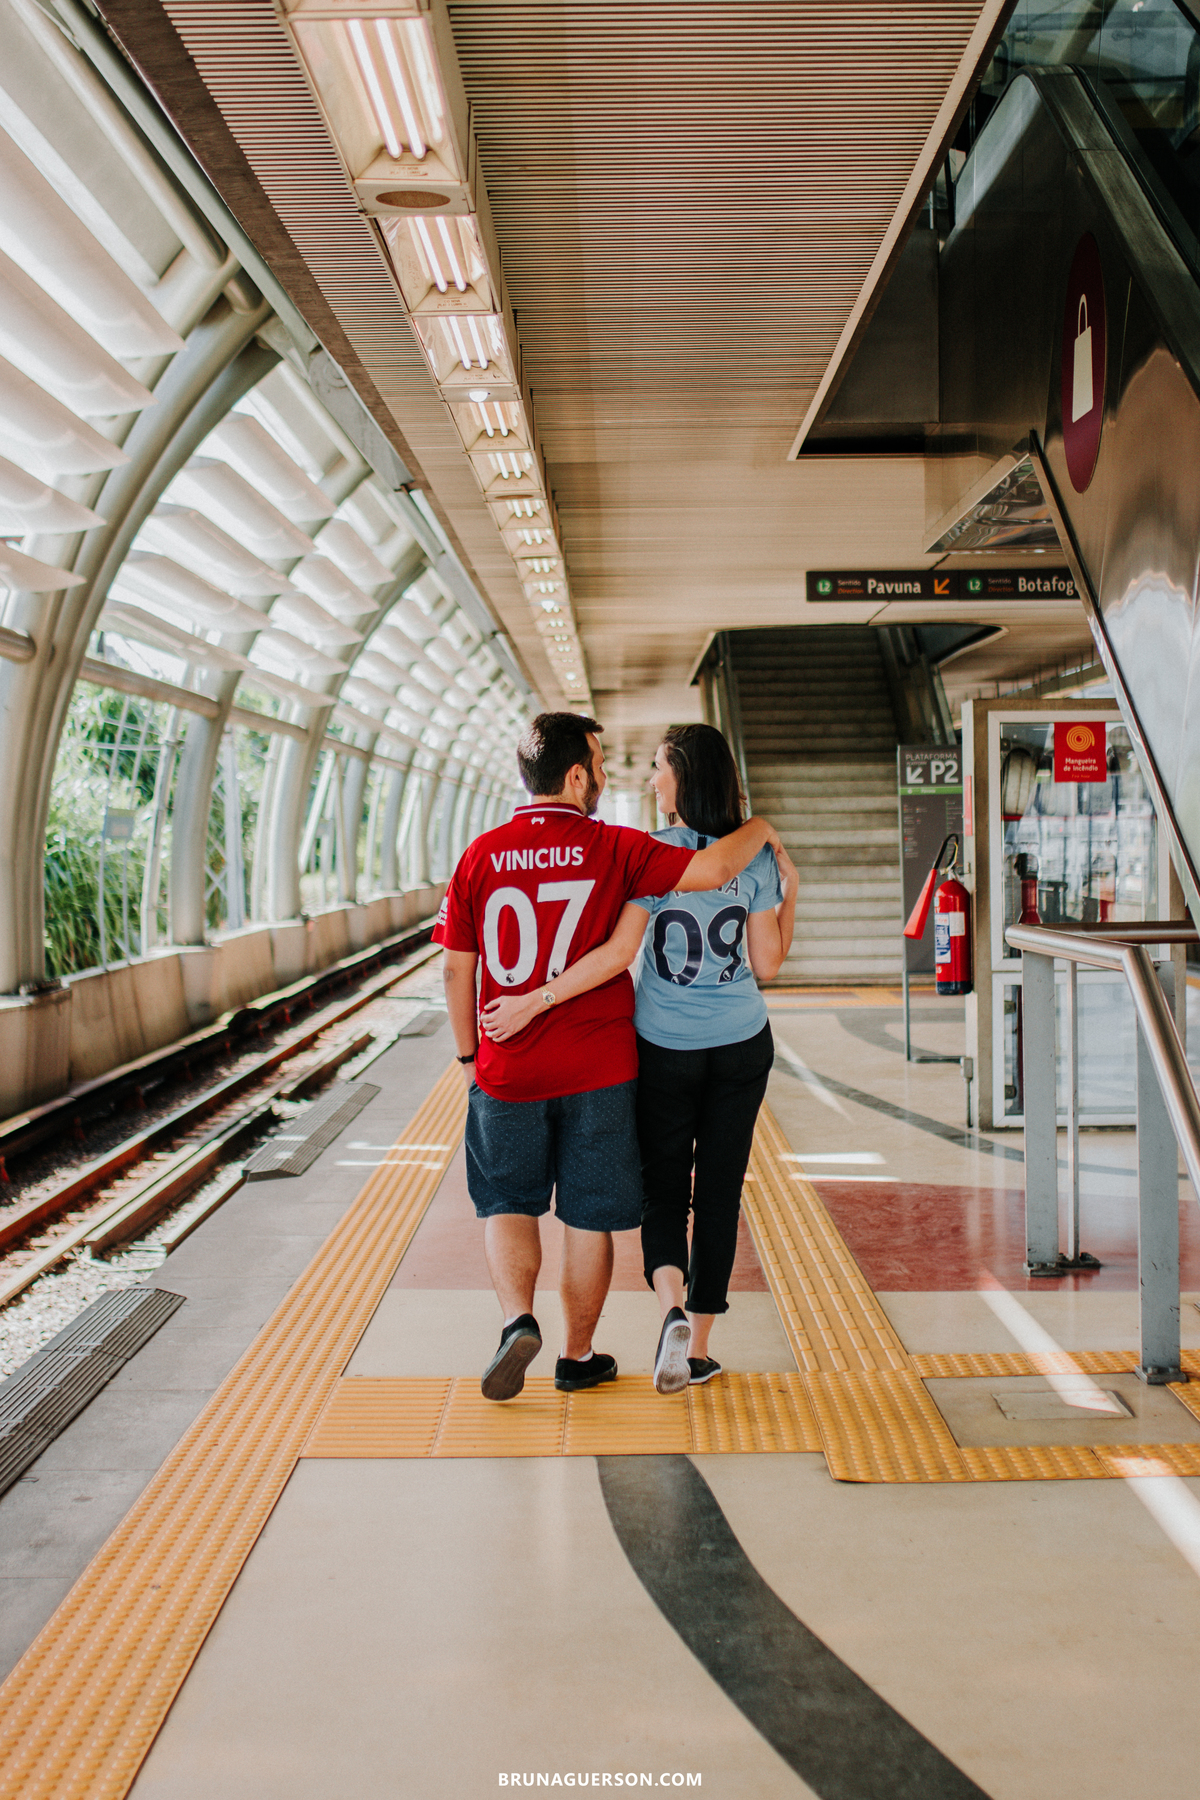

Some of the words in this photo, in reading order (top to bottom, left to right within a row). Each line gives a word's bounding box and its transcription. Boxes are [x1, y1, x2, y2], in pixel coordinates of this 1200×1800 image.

[819, 581, 831, 592] L2
[867, 578, 922, 594] Pavuna
[969, 580, 981, 591] L2
[1018, 575, 1078, 596] Botafog
[905, 753, 958, 761] PLATAFORMA
[1065, 757, 1097, 766] Mangueira
[931, 760, 959, 784] P2
[490, 846, 584, 873] VINICIUS
[483, 879, 596, 987] 07
[653, 904, 749, 987] 09
